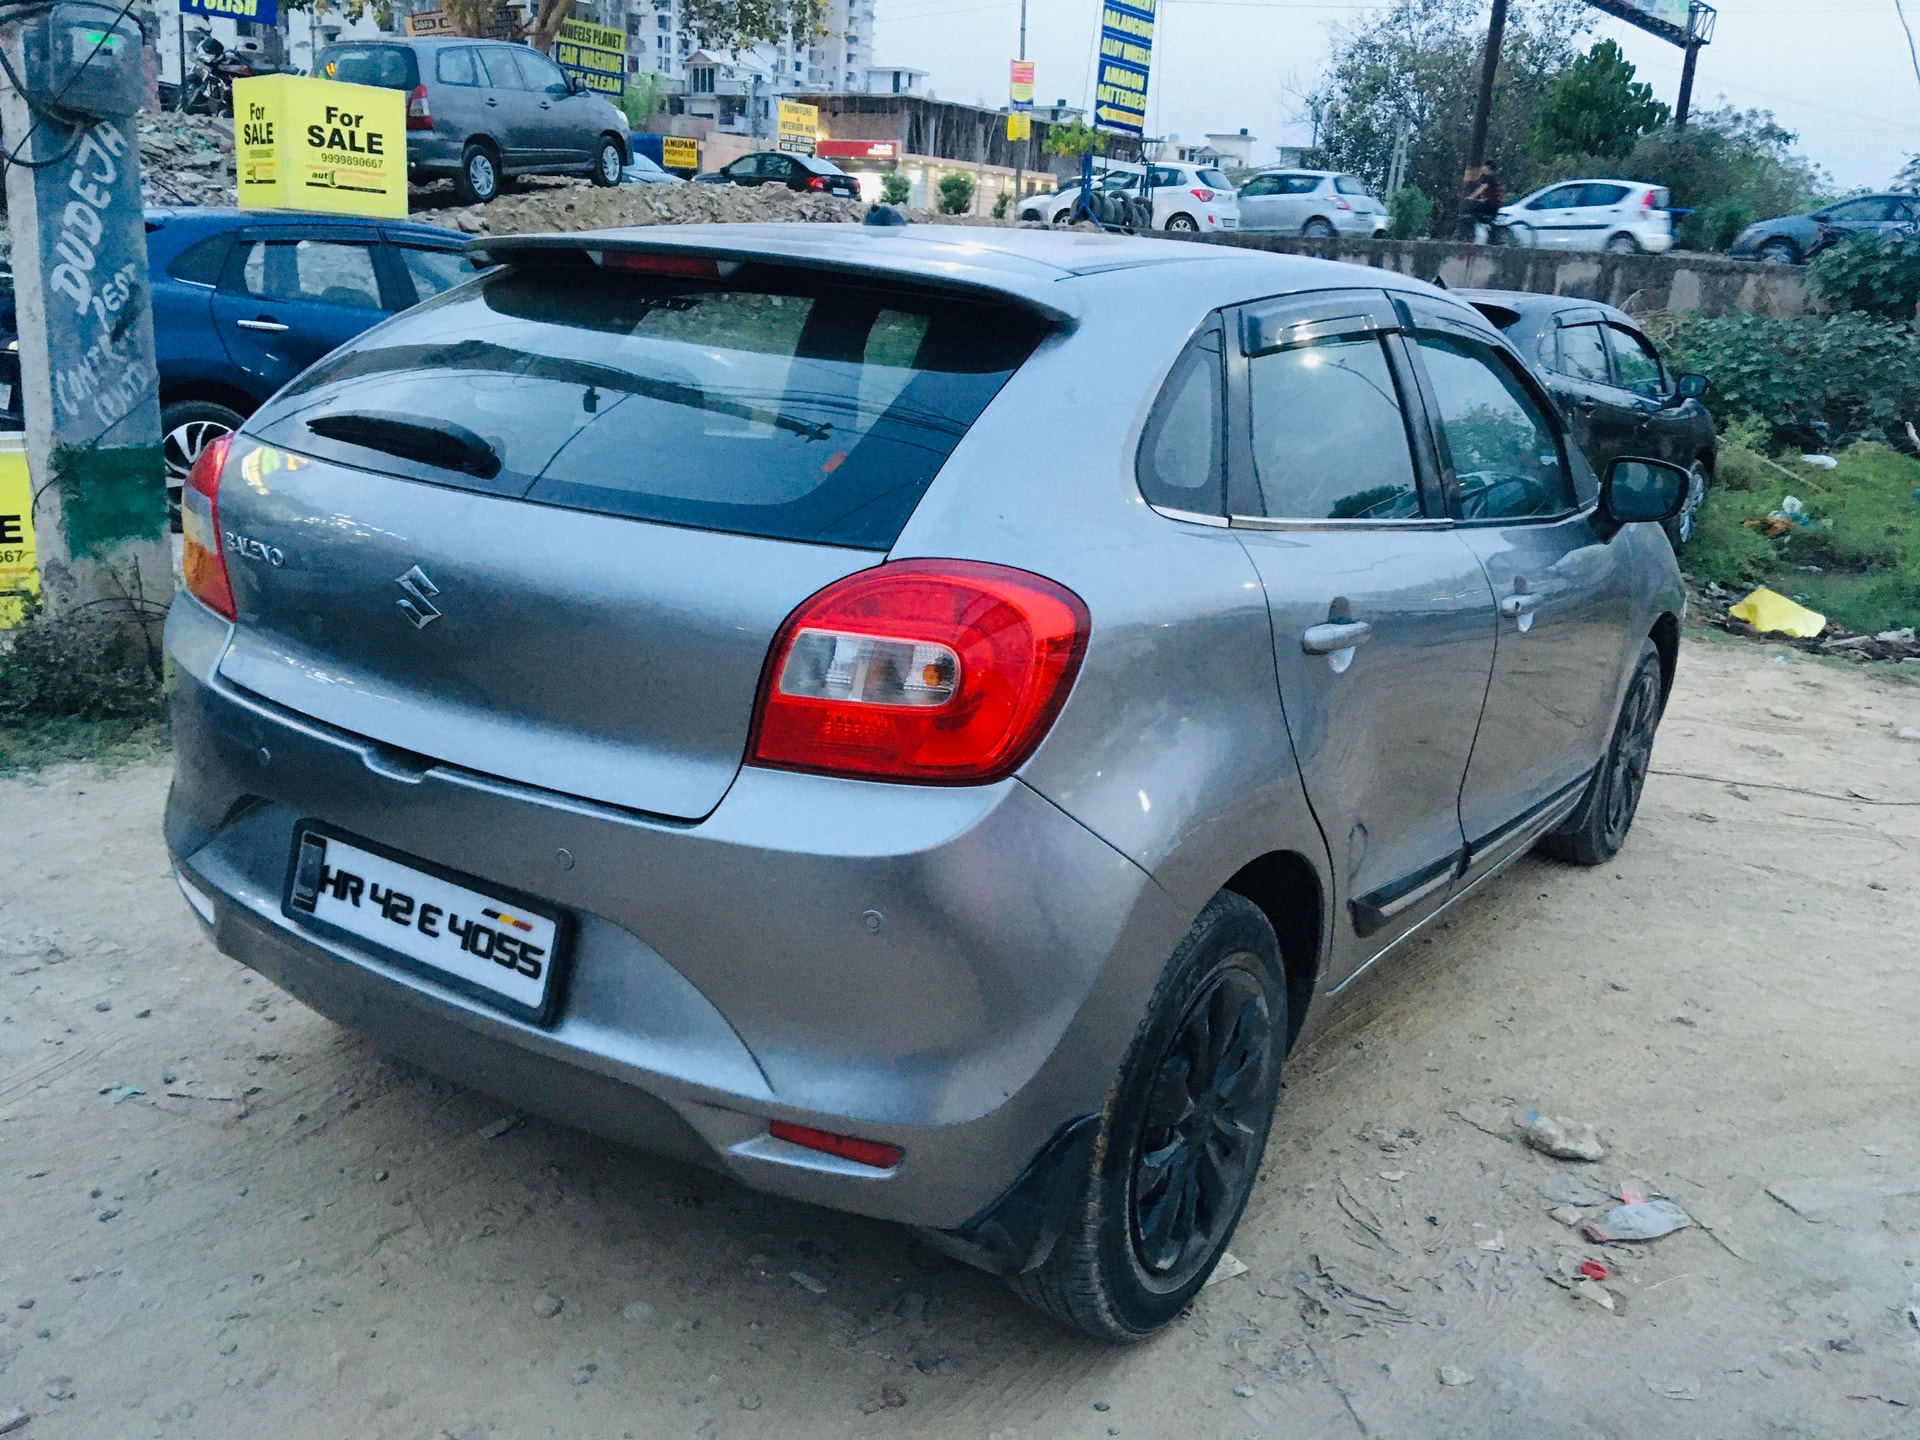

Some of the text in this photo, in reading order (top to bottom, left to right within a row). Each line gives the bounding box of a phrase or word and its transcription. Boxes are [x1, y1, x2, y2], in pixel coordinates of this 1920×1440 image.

[559, 22, 622, 50] WHEELS PLANET
[1104, 8, 1154, 40] BALANCING
[559, 44, 622, 74] CAR WASHING
[586, 73, 622, 93] CLEAN
[1103, 65, 1145, 91] AMARON
[1097, 83, 1146, 111] BATTERIES
[250, 103, 265, 121] For
[325, 106, 364, 128] For
[244, 122, 274, 146] SALE
[307, 125, 384, 155] SALE
[320, 152, 384, 169] 9999890667
[317, 864, 545, 980] HR 42 E 4055
